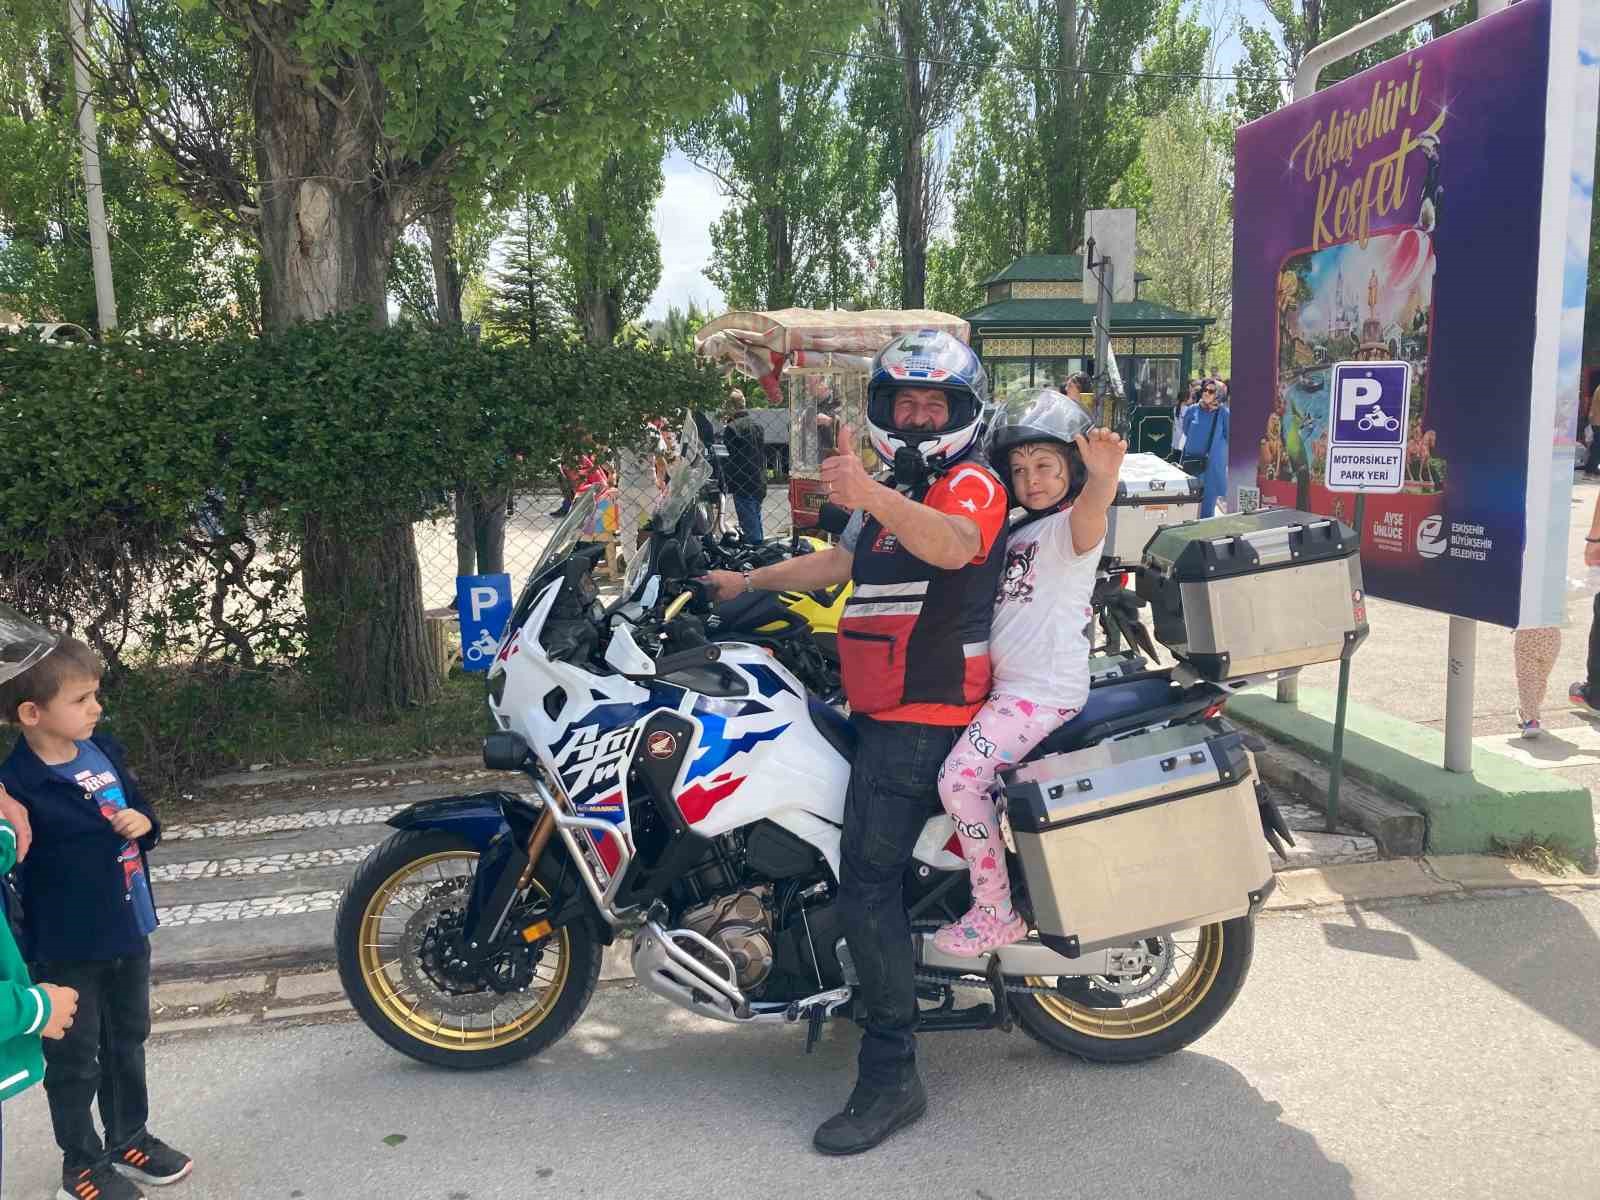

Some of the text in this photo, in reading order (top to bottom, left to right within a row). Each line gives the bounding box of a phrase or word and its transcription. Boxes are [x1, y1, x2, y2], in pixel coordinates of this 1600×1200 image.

[1340, 378, 1382, 420] P
[1333, 454, 1398, 465] MOTORSİKLET
[1340, 470, 1365, 480] PARK
[470, 587, 498, 622] P
